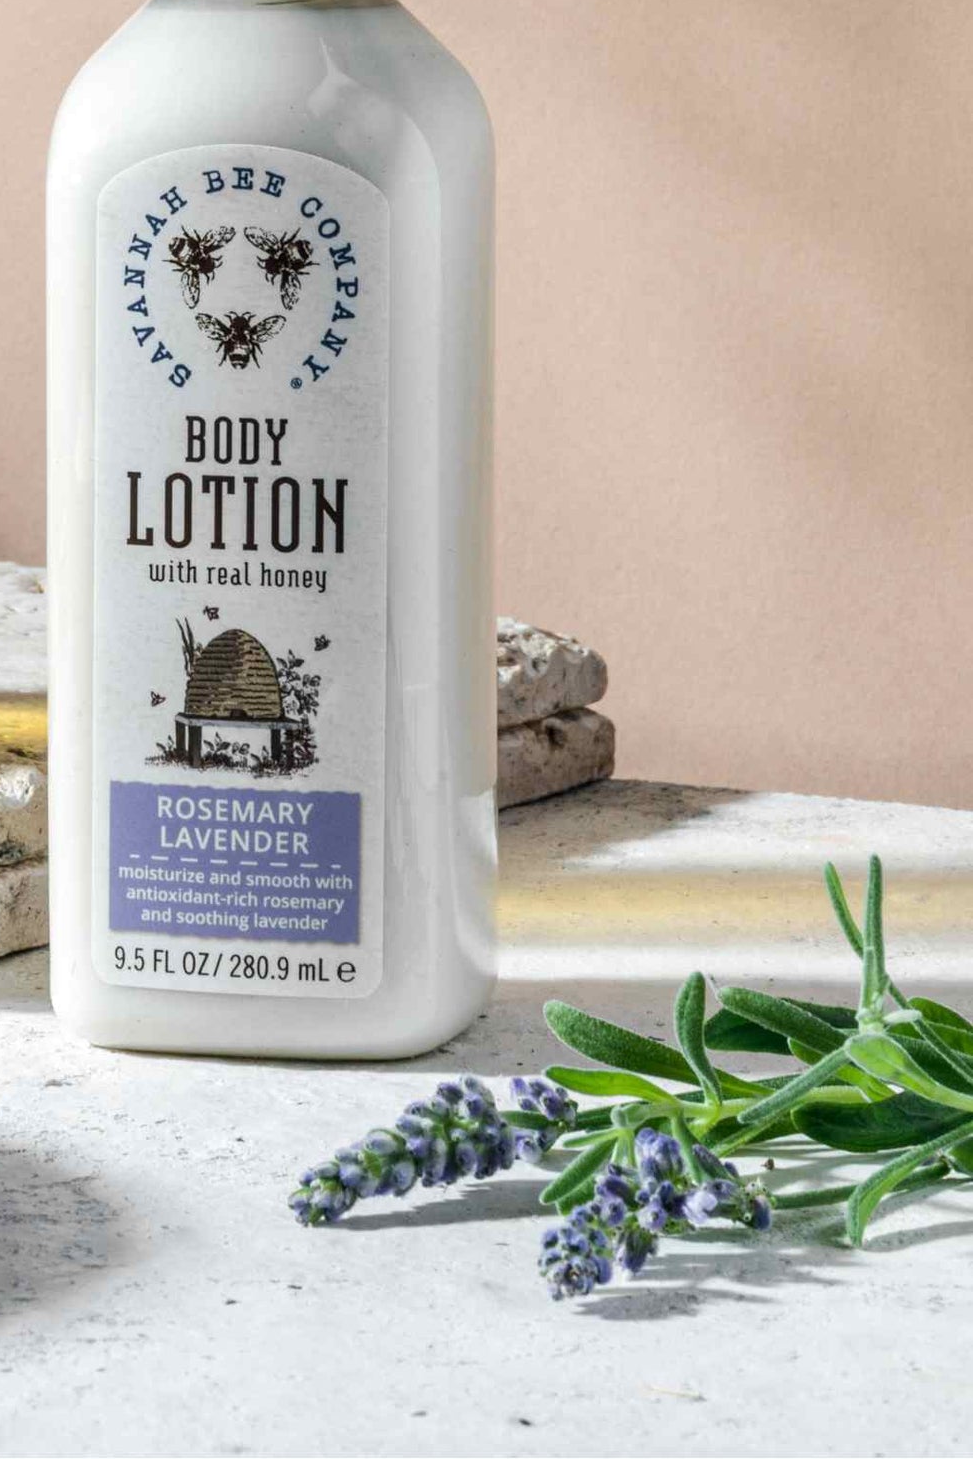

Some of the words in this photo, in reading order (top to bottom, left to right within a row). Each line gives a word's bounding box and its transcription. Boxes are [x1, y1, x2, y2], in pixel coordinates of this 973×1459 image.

[124, 186, 192, 388] SAVANNAH
[202, 167, 286, 197] BEE
[185, 415, 288, 465] BODY
[126, 471, 348, 553] LOTION
[149, 559, 197, 584] with
[207, 561, 251, 586] real
[260, 562, 327, 593] honey
[157, 795, 314, 825] ROSEMARY
[160, 826, 310, 855] LAVENDER
[119, 865, 204, 884] moisturize
[209, 868, 241, 886] and
[246, 871, 311, 889] smooth
[315, 874, 353, 890] with
[126, 886, 258, 907] antioxidant-rich
[263, 895, 345, 914] rosemary
[141, 907, 171, 924] and
[176, 909, 249, 931] soothing
[253, 913, 328, 930] lavender
[114, 946, 145, 971] 9.5
[153, 949, 175, 974] FL
[298, 958, 329, 982] mL
